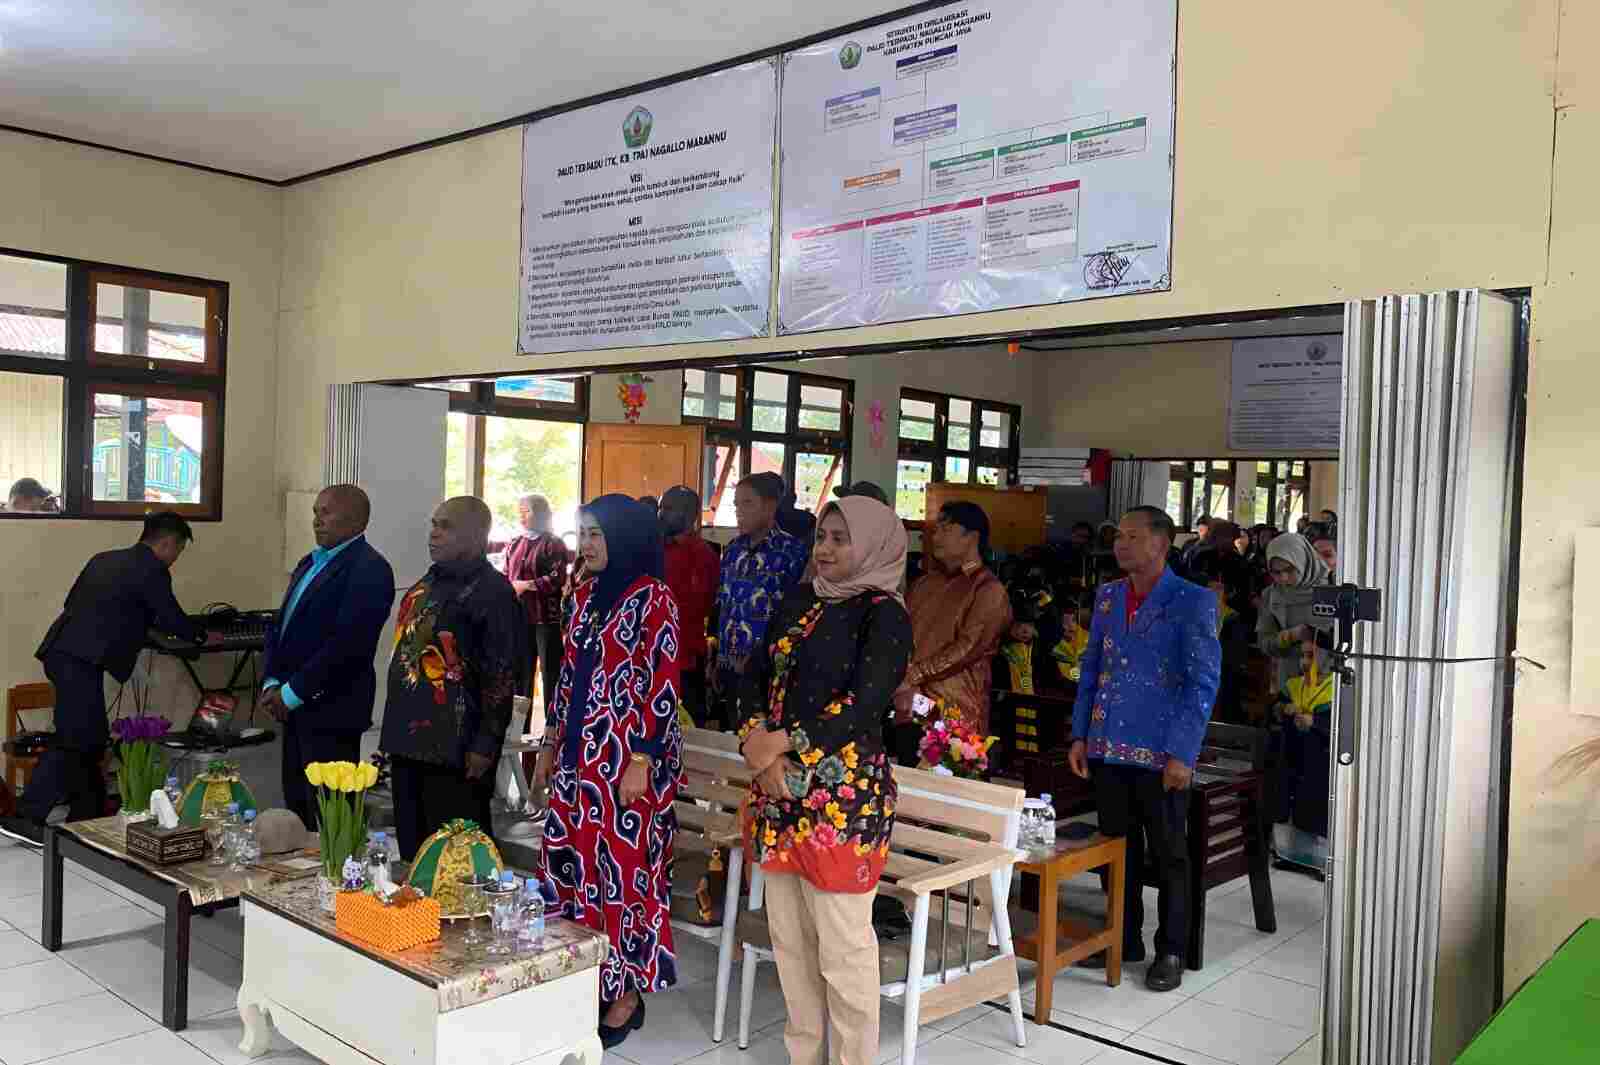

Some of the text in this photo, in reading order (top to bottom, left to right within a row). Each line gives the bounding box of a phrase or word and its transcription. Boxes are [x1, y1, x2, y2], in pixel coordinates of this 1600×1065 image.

[650, 141, 686, 158] NAGALLO
[686, 130, 727, 150] MARANNU
[629, 173, 643, 184] VISI
